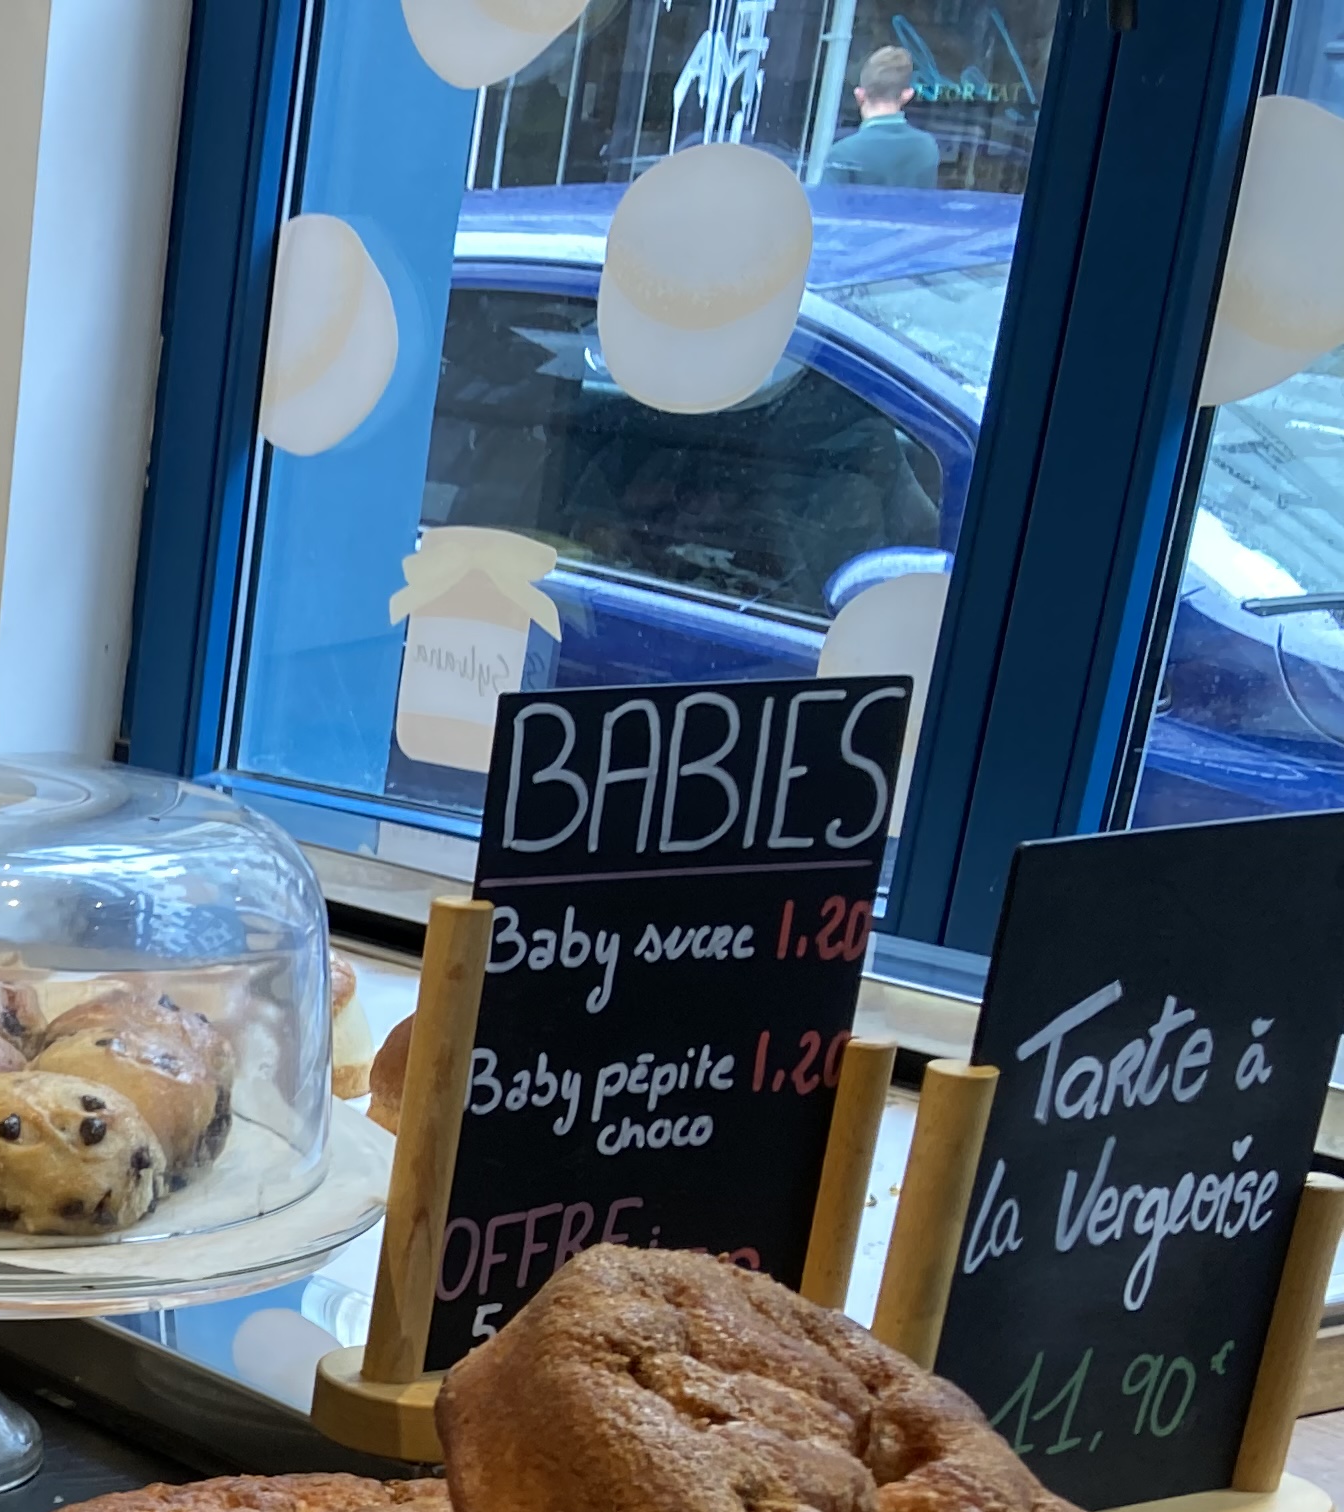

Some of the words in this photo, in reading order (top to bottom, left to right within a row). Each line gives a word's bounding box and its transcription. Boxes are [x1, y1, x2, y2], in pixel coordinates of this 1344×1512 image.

[502, 686, 906, 854] BABIES
[485, 905, 620, 1013] Baby
[634, 921, 755, 964] sucre
[464, 1047, 582, 1136] Baby
[591, 1043, 734, 1123] pépite
[1016, 979, 1214, 1126] Tarte
[1235, 1016, 1276, 1091] à
[596, 1115, 714, 1156] choco
[436, 1196, 645, 1301] OFFRE
[963, 1157, 1023, 1275] la
[1055, 1134, 1280, 1311] Vergeoise
